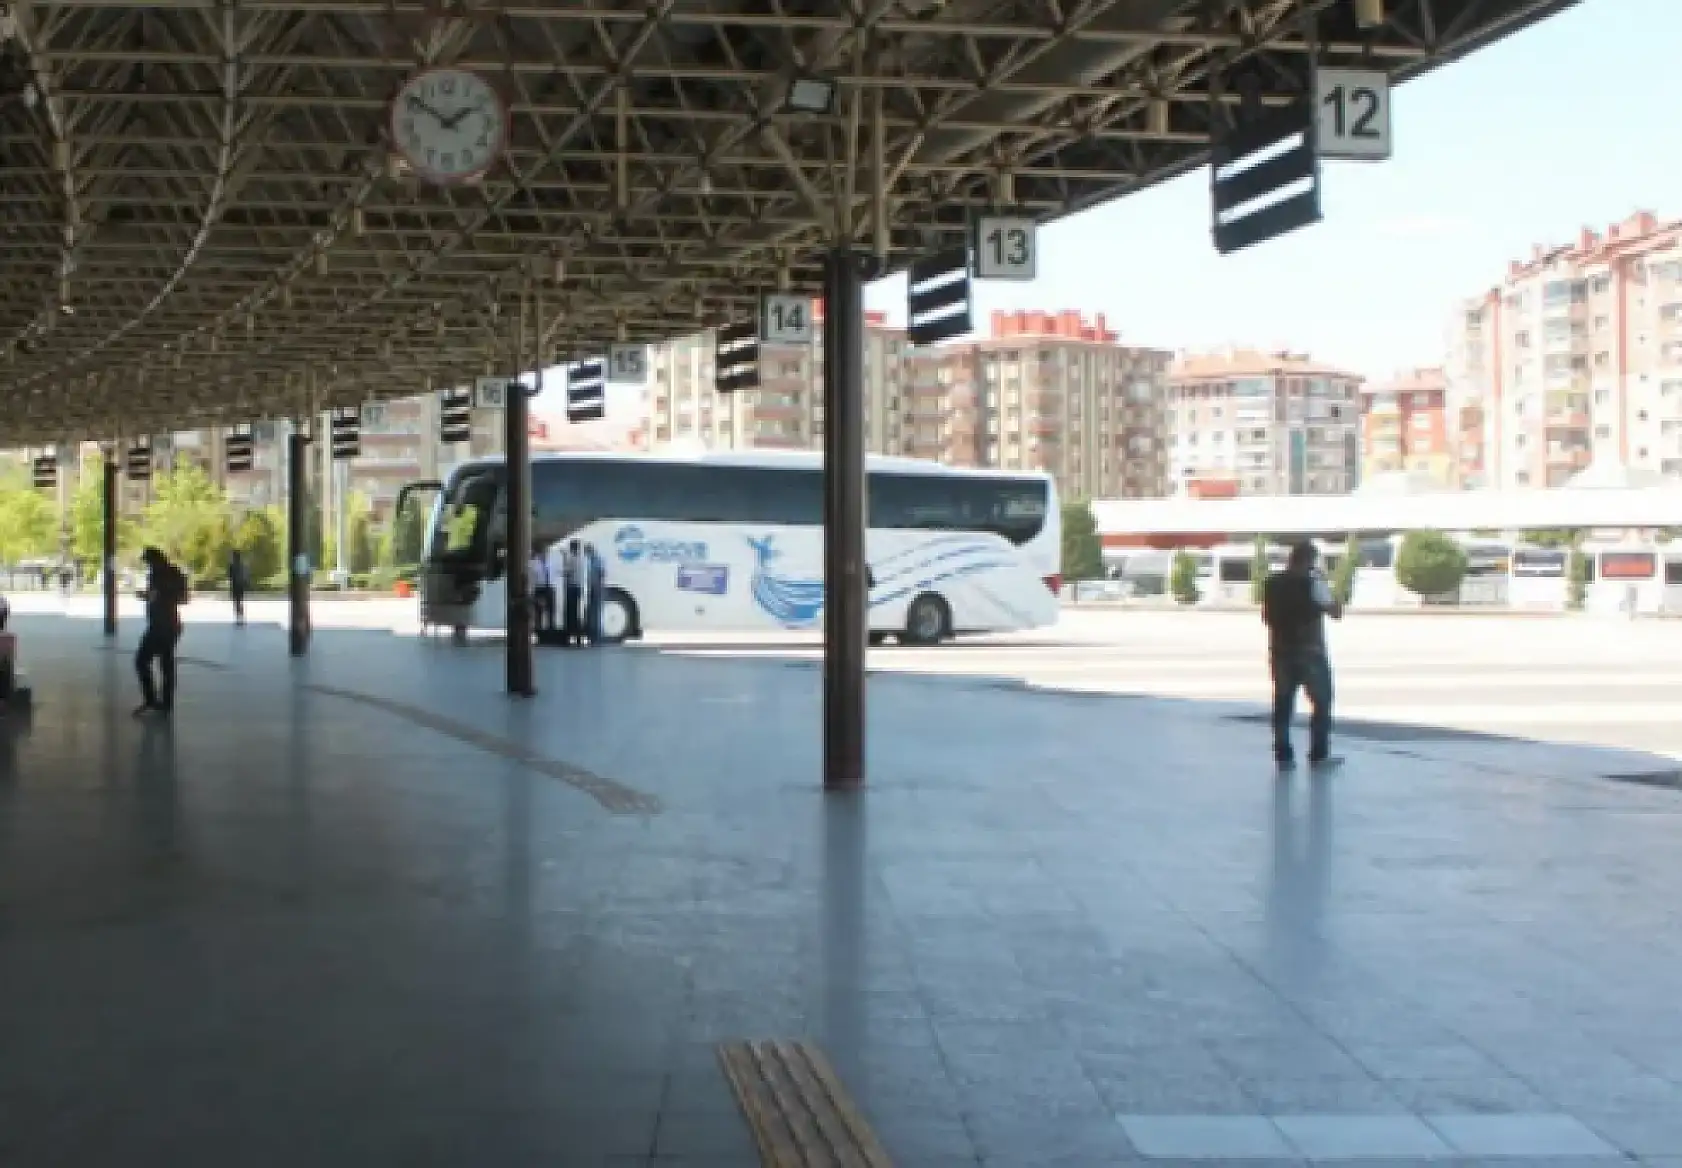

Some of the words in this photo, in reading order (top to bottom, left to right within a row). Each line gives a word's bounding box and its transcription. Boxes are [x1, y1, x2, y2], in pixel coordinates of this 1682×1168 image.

[1323, 84, 1380, 140] 12
[986, 228, 1030, 267] 13
[770, 304, 808, 334] 14
[615, 350, 644, 374] 15
